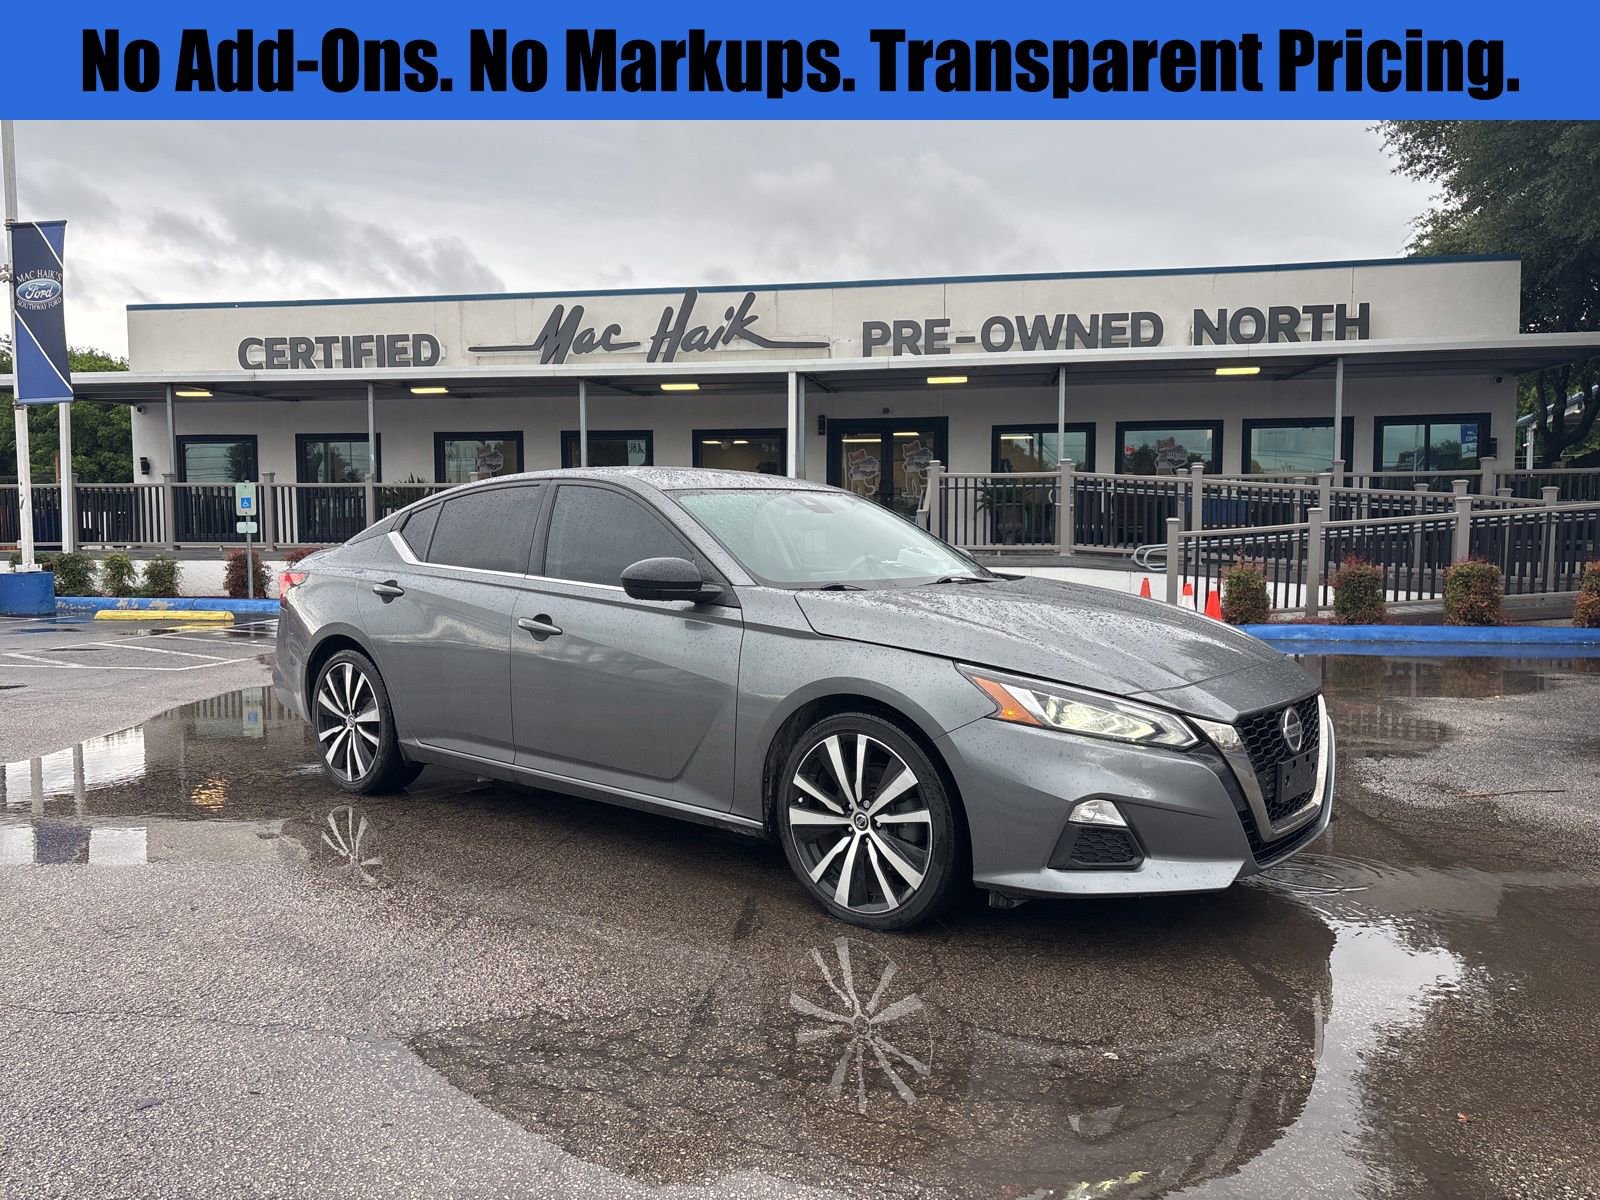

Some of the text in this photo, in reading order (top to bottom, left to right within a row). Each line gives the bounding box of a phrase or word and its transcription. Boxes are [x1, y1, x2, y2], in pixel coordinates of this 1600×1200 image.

[16, 269, 62, 284] MAC HAIK'S
[16, 296, 62, 311] SOUTHWAY FORD
[25, 282, 54, 299] Ford
[468, 287, 830, 365] Mac Haik
[862, 302, 1371, 358] PRE-OWNED NORTH
[238, 333, 441, 370] CERTIFIED
